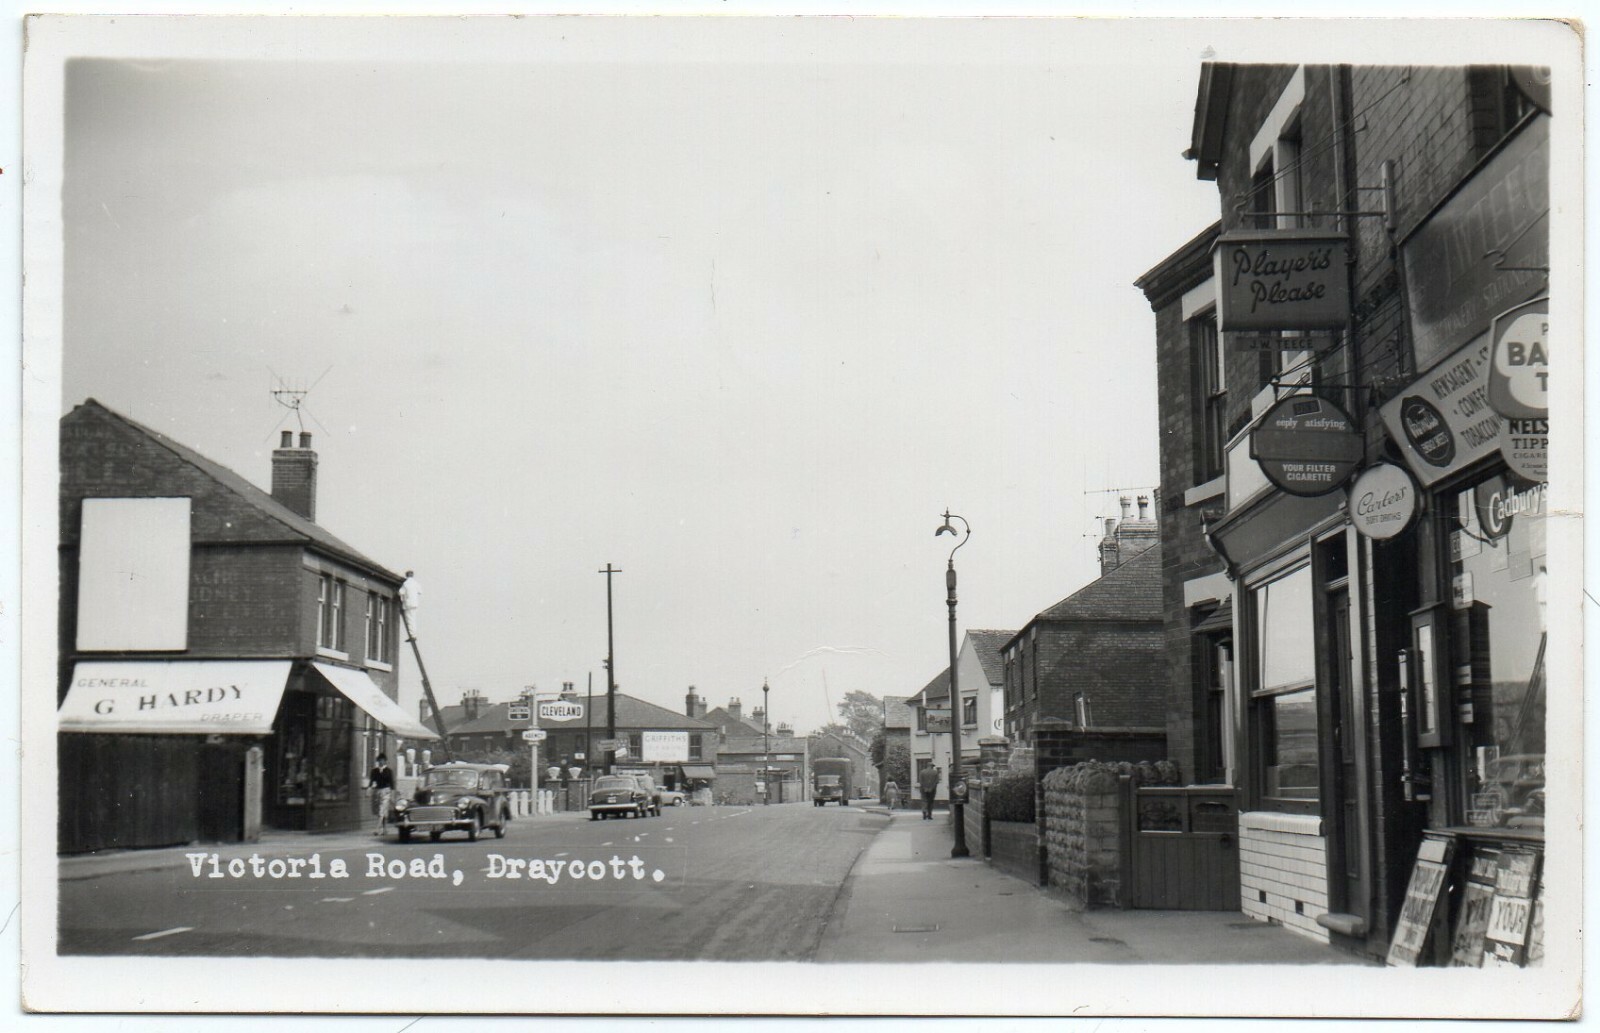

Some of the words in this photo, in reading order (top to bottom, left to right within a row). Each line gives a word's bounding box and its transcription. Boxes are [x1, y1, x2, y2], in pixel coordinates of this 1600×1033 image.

[1250, 279, 1326, 314] Please
[1275, 338, 1314, 350] TEECE
[1507, 341, 1549, 366] BA
[1430, 358, 1479, 400] NEWSAGENT
[1304, 417, 1347, 431] atisfying
[1511, 438, 1549, 450] TIPP
[1282, 463, 1304, 472] YOUR
[1306, 464, 1337, 473] FILTER
[1286, 472, 1332, 482] CIGARETTE
[77, 677, 150, 689] GENERAL
[94, 698, 116, 716] G
[138, 684, 246, 712] HARDY
[541, 705, 581, 717] CLEVELAND
[200, 712, 265, 723] DRAPER
[644, 734, 687, 743] GRIFFITHS
